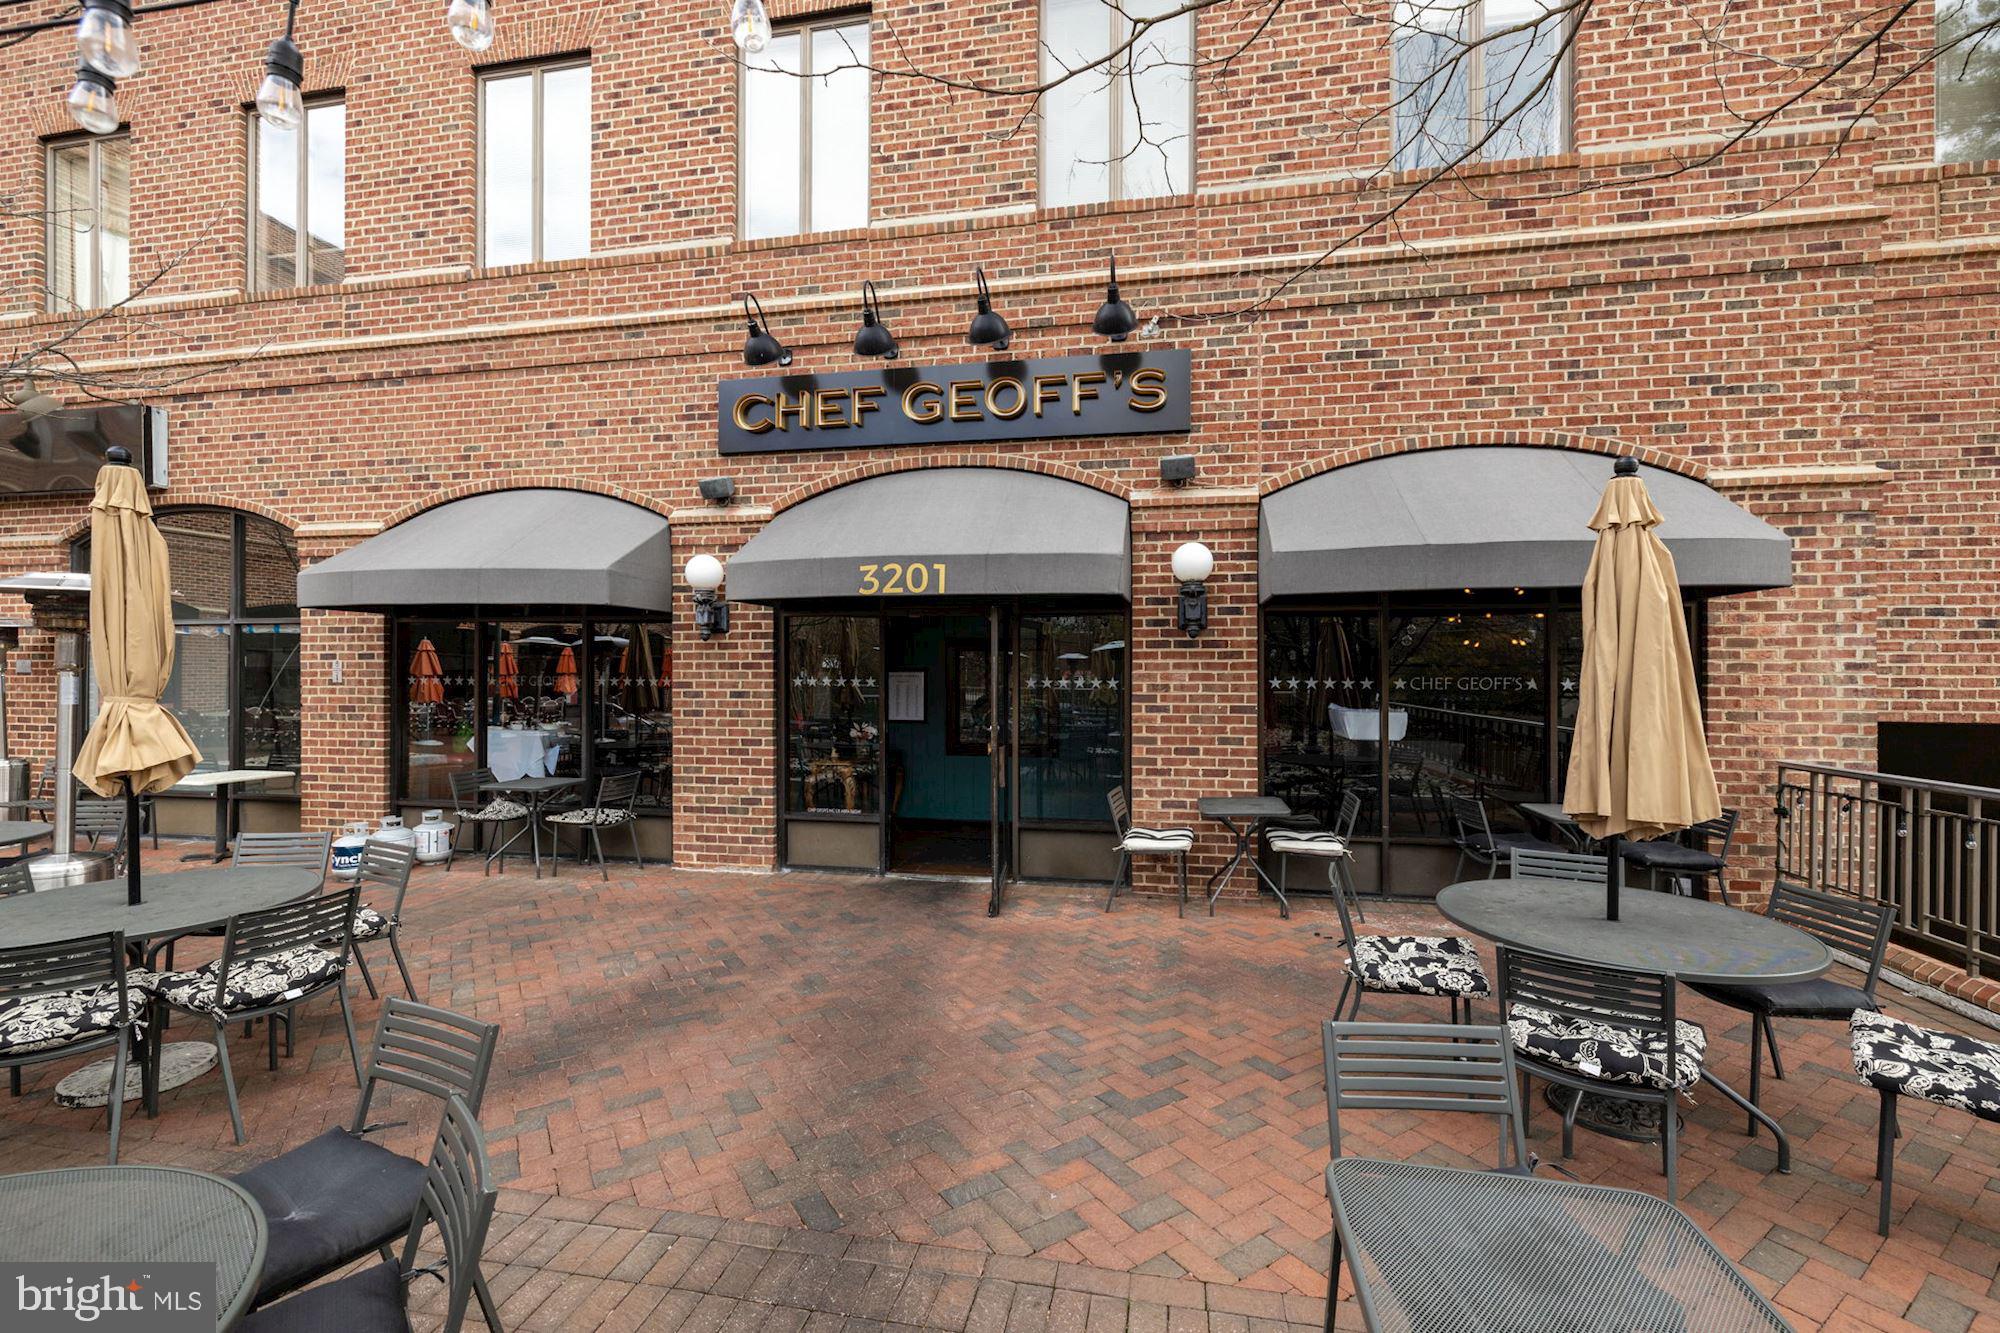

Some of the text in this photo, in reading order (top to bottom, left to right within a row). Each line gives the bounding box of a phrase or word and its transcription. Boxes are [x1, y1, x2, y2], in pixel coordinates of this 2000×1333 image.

[733, 368, 1168, 433] CHEF GEOFF'S
[858, 563, 948, 596] 3201
[1409, 676, 1523, 691] CHEF GEOFF'S
